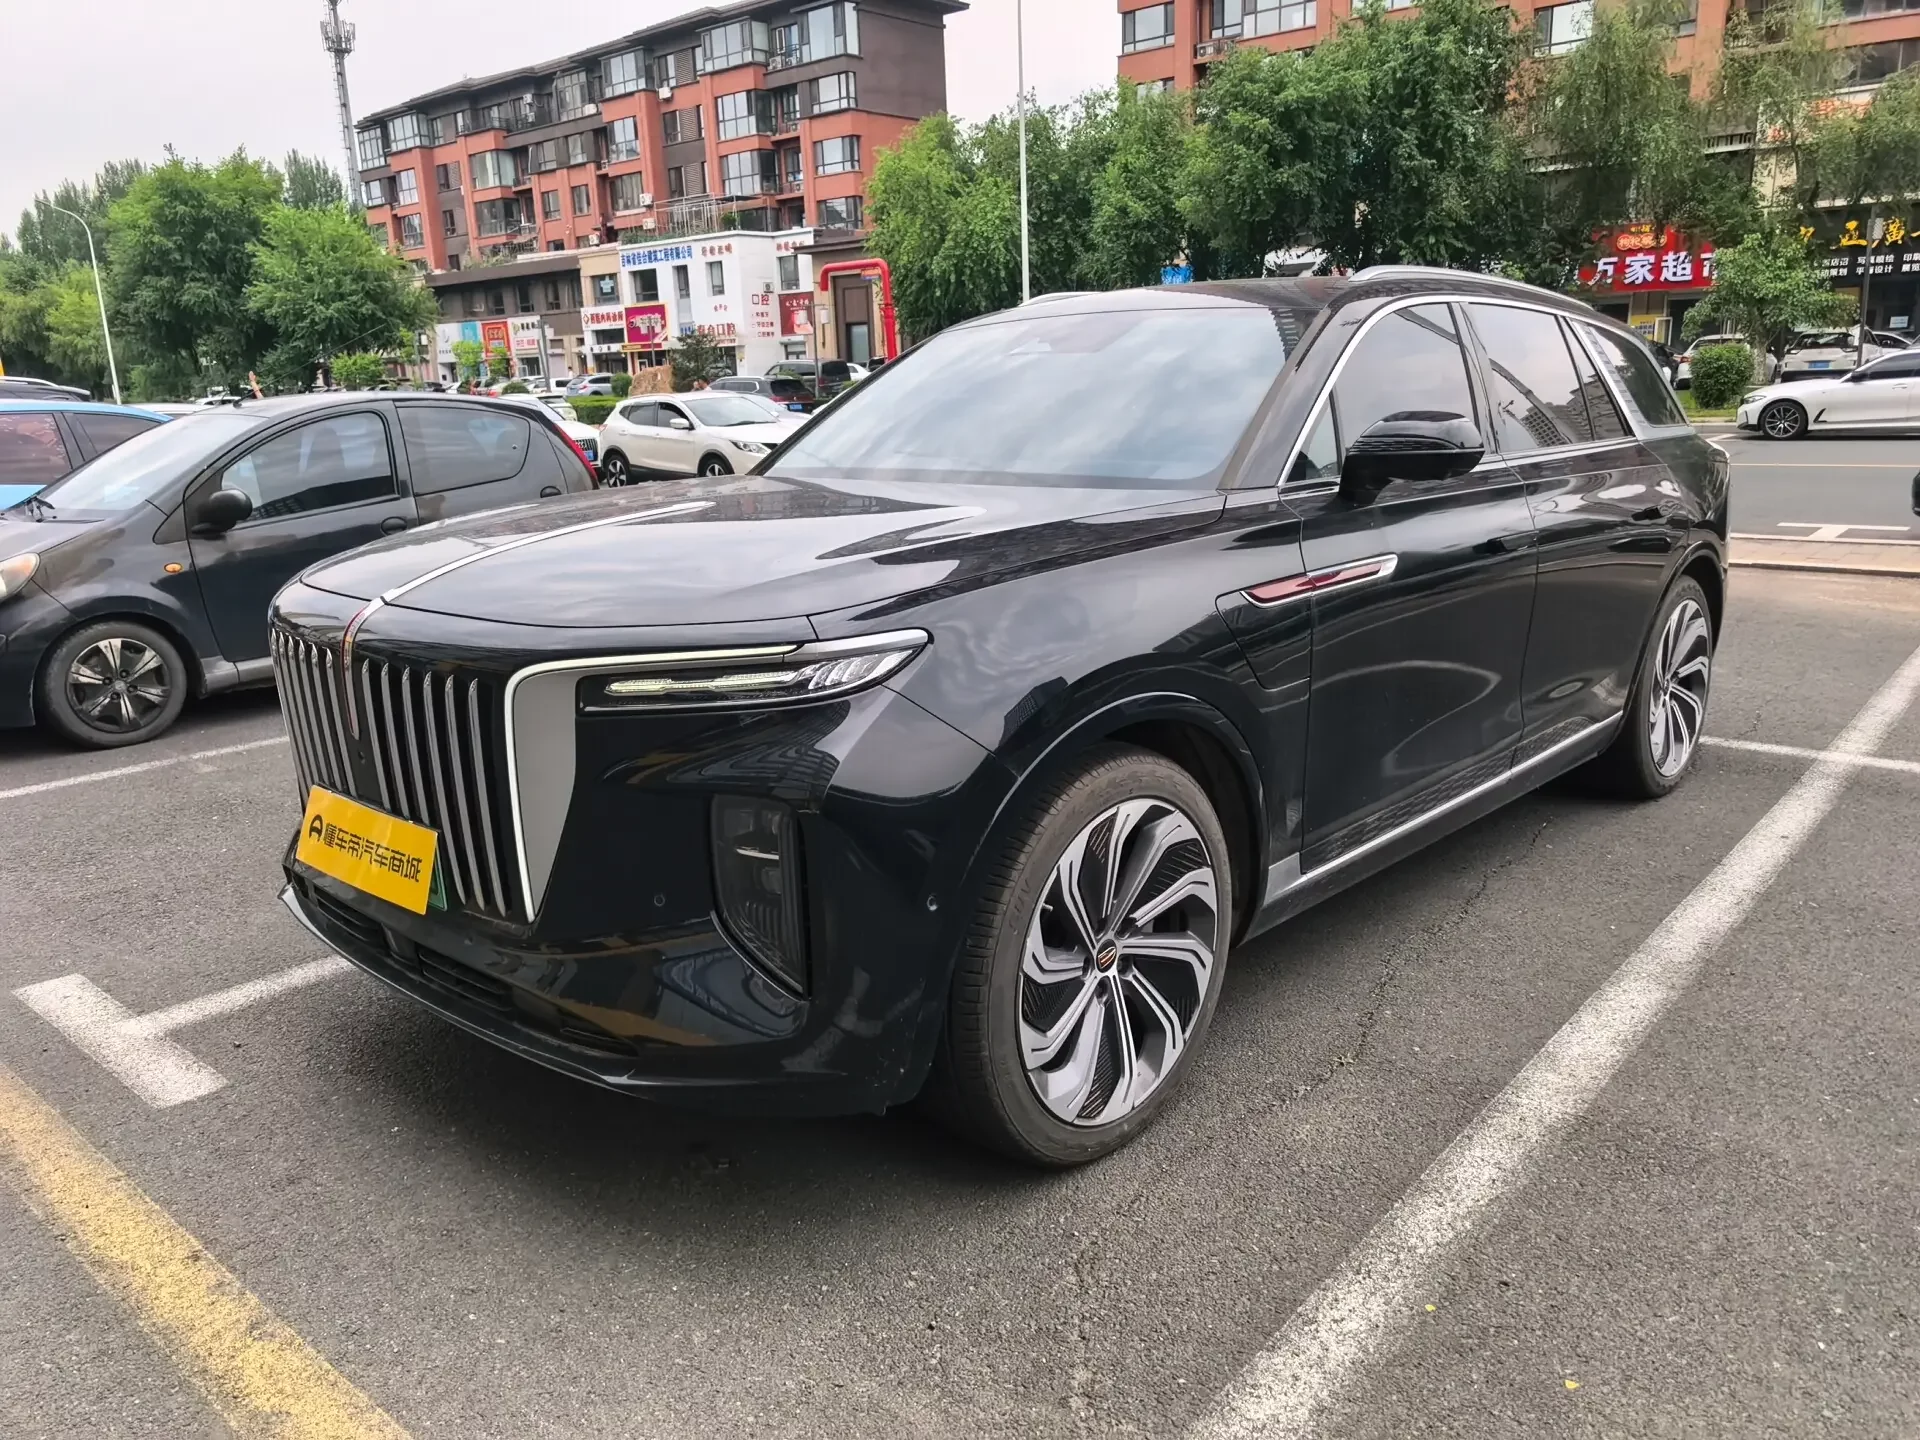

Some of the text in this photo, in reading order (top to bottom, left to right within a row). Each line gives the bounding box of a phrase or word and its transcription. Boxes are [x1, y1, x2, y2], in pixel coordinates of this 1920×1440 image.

[323, 822, 423, 883] 懂车帝汽车商城
